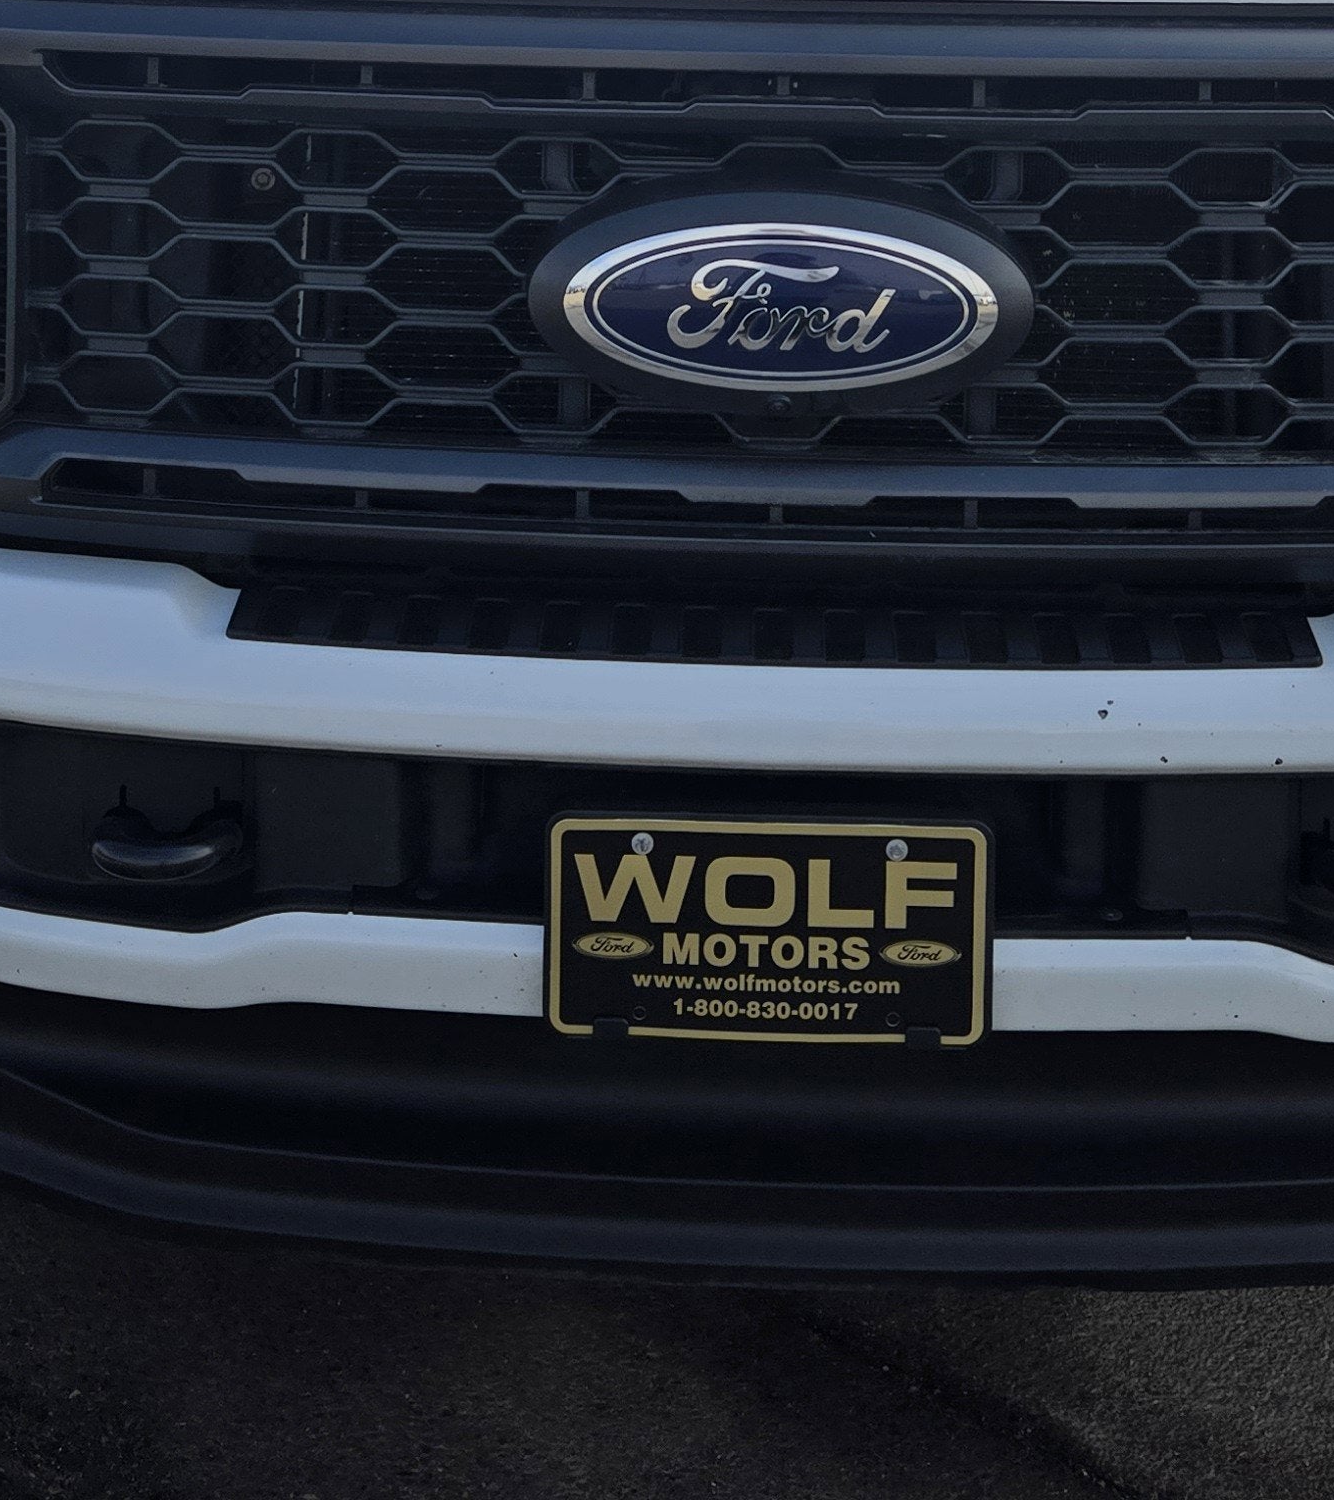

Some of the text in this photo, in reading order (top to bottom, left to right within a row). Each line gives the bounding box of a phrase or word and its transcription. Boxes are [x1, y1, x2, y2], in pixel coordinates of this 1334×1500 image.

[667, 259, 897, 353] Ford
[574, 853, 958, 930] WOLF
[590, 935, 635, 955] Ford
[662, 932, 870, 971] MOTORS
[896, 943, 942, 963] Ford
[632, 973, 901, 995] www.wolfmotors.com
[673, 998, 859, 1021] 1-800-830-0017
